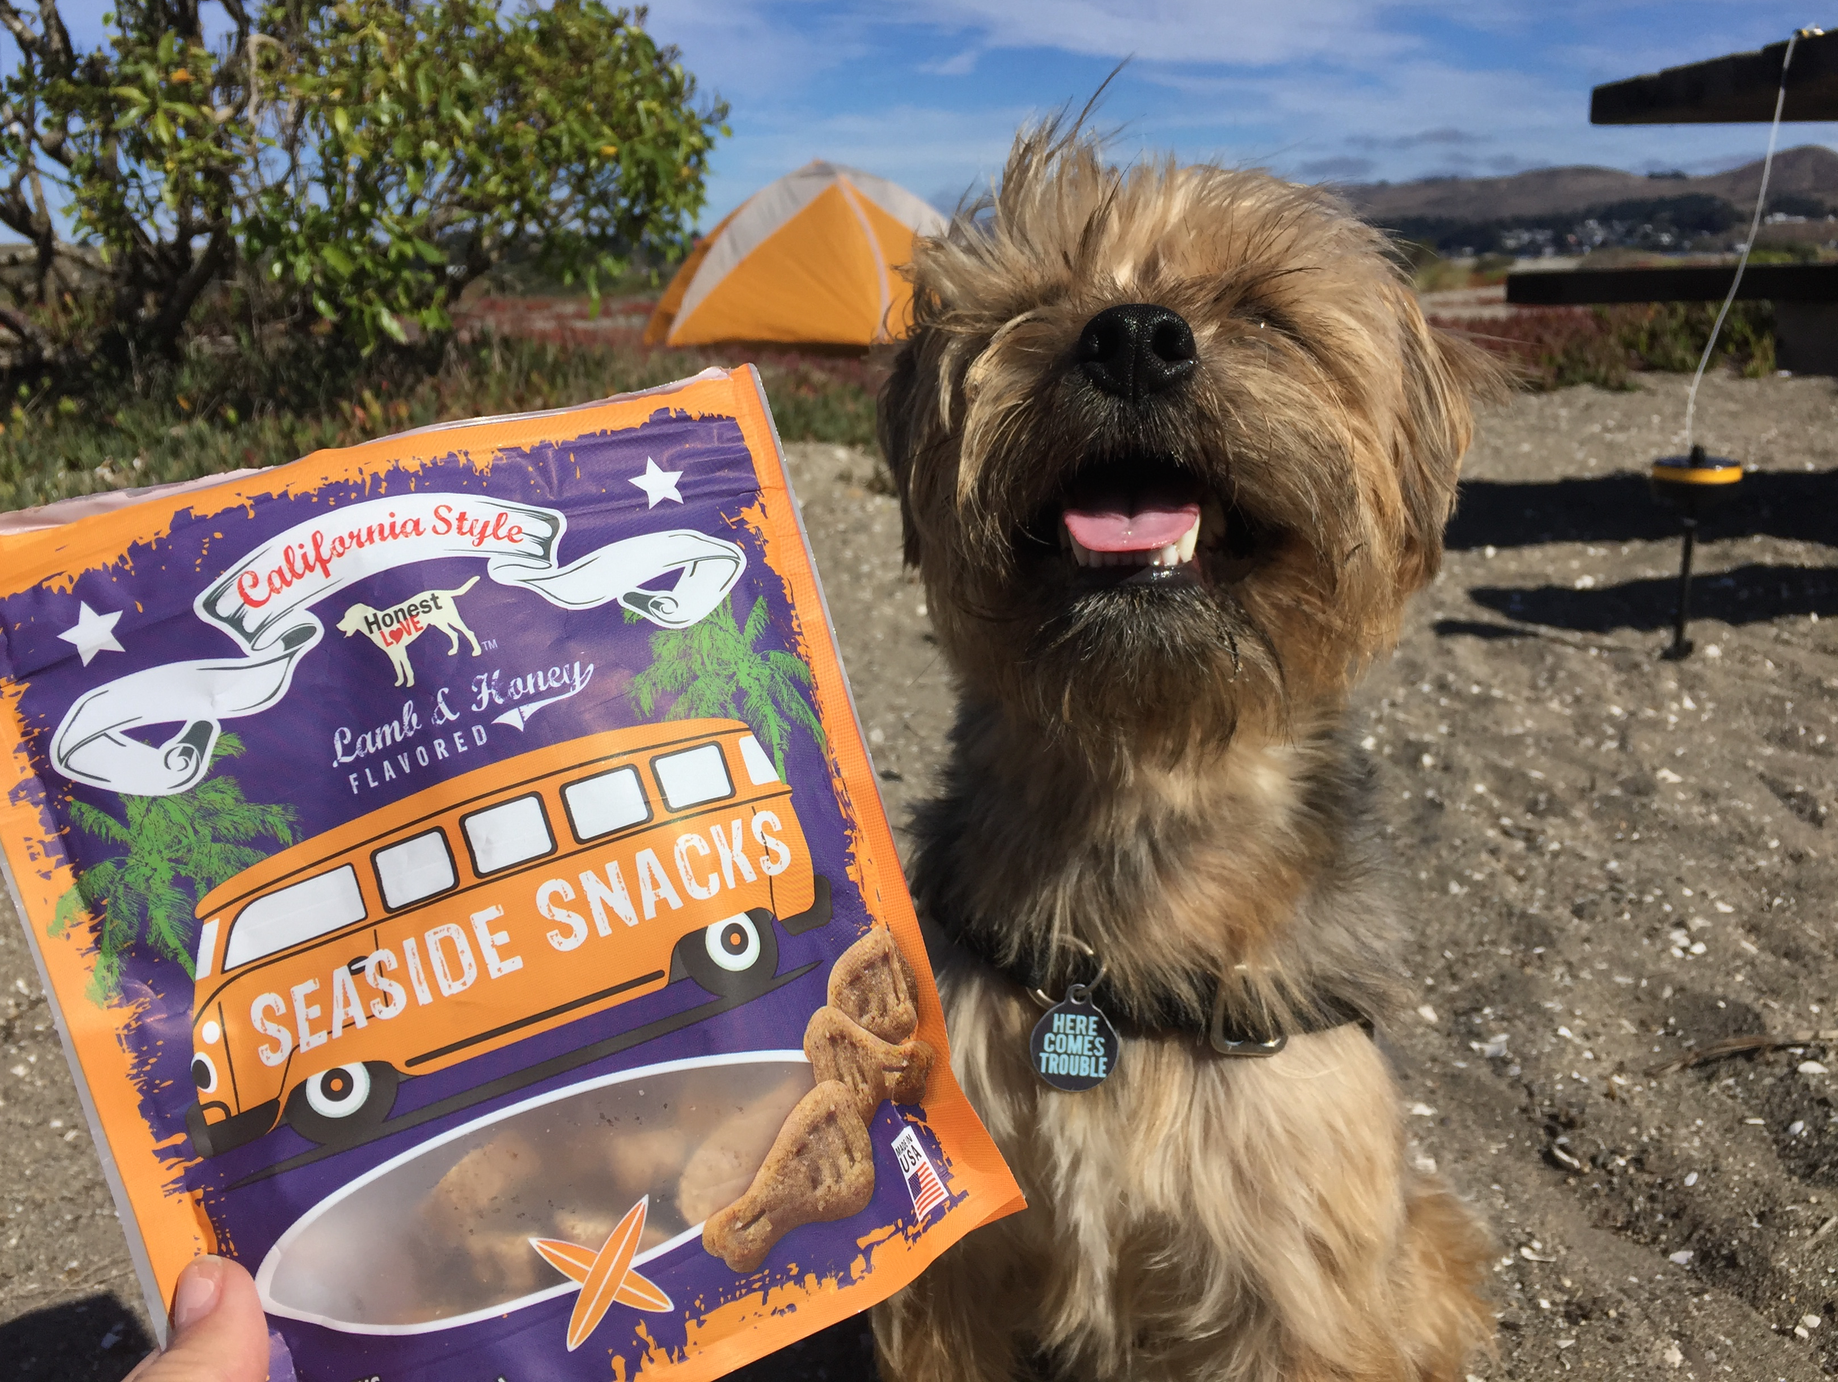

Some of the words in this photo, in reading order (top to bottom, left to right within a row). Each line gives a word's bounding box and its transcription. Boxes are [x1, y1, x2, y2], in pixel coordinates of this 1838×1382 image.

[237, 511, 427, 608] California
[431, 504, 525, 547] Style
[364, 593, 443, 634] Honest
[332, 700, 422, 768] Lamb
[431, 688, 460, 726] &
[471, 661, 595, 713] Honey
[348, 724, 489, 795] FLAVORED
[249, 904, 524, 1067] SEASIDE
[535, 810, 792, 952] SNACKS
[1052, 1013, 1099, 1036] HERE
[1043, 1032, 1106, 1056] COMES
[1039, 1052, 1108, 1078] TROUBLE
[895, 1139, 908, 1156] MADE
[900, 1145, 922, 1173] USA
